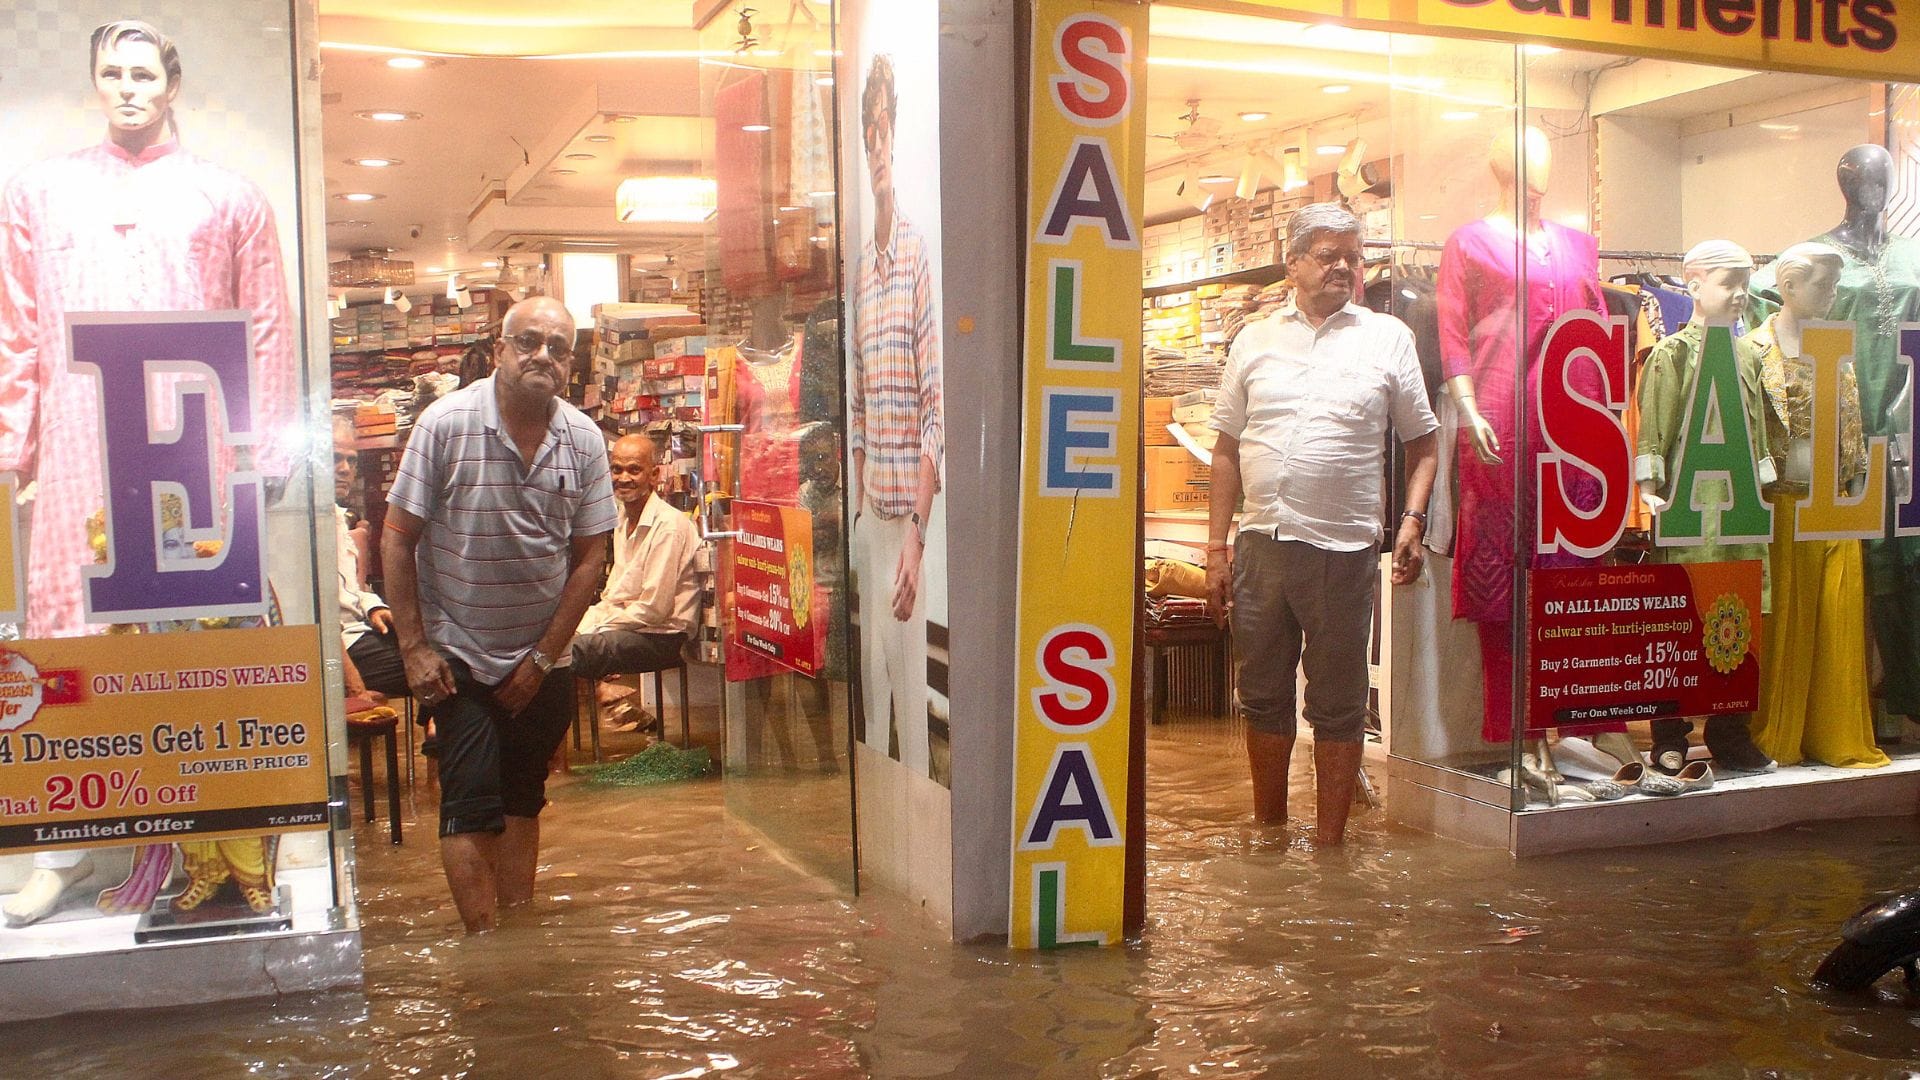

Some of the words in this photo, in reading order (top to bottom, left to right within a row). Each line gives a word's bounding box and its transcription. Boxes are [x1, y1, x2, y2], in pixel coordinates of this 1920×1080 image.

[1036, 13, 1141, 497] SALE
[1537, 309, 1920, 558] SAL
[1599, 573, 1655, 586] Bandhan
[1544, 601, 1564, 615] ON
[1566, 599, 1592, 614] ALL
[1594, 597, 1640, 612] LADIES
[1642, 595, 1687, 610] WEARS
[1540, 659, 1560, 673] Buy
[1562, 657, 1569, 669] 2
[1624, 654, 1641, 666] Get
[1645, 641, 1680, 664] 15%
[1682, 650, 1698, 661] Off
[93, 675, 124, 695] ON
[130, 672, 172, 692] ALL
[177, 668, 227, 690] KIDS
[232, 664, 307, 686] WEARS
[1539, 686, 1560, 700] Buy
[1562, 684, 1569, 696] 4
[1624, 680, 1641, 691] Get
[1643, 667, 1679, 690] 20%
[1683, 675, 1698, 687] Off
[1571, 709, 1587, 719] For
[1589, 708, 1607, 719] One
[1609, 706, 1634, 717] Week
[1636, 704, 1658, 716] Only
[1727, 700, 1750, 710] APPLY
[22, 733, 144, 762] Dresses
[152, 723, 204, 754] Get
[215, 721, 229, 750] 1
[238, 718, 306, 748] Free
[180, 759, 248, 775] LOWER
[252, 754, 309, 770] PRICE
[0, 797, 39, 815] lat
[46, 769, 149, 812] 20%
[157, 785, 197, 805] Off
[34, 822, 127, 842] Limited
[134, 818, 195, 835] Offer
[289, 813, 323, 824] APPLY
